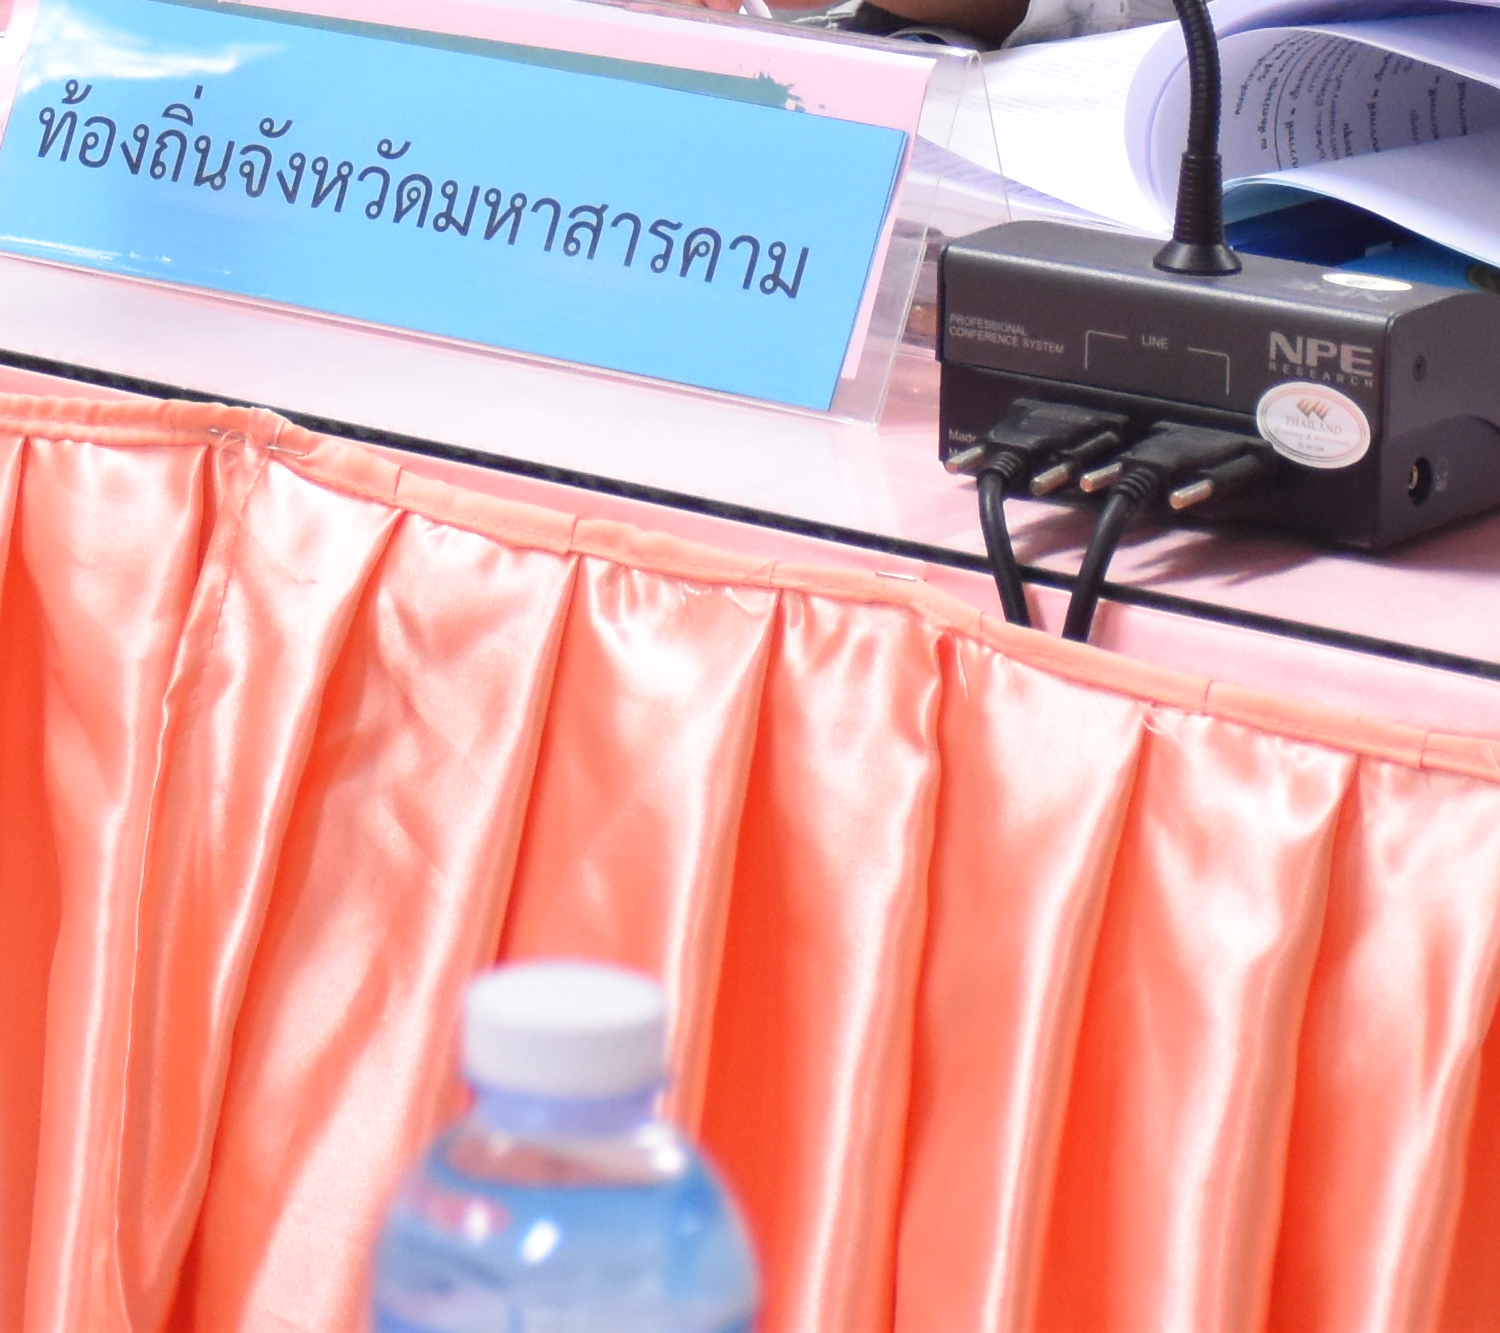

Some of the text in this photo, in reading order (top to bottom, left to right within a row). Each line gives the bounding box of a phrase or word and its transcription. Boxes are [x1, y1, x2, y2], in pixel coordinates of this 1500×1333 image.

[35, 79, 810, 300] ท้องถิ่นจังหวัดมหาสารคาม
[949, 313, 1027, 336] PROFESSIONAL
[948, 326, 1065, 355] CONFERENCE SYSTEM
[1141, 334, 1170, 351] LINE
[1267, 331, 1375, 380] NPE
[1267, 361, 1375, 389] RESEARCH
[1284, 415, 1343, 436] THAILAND
